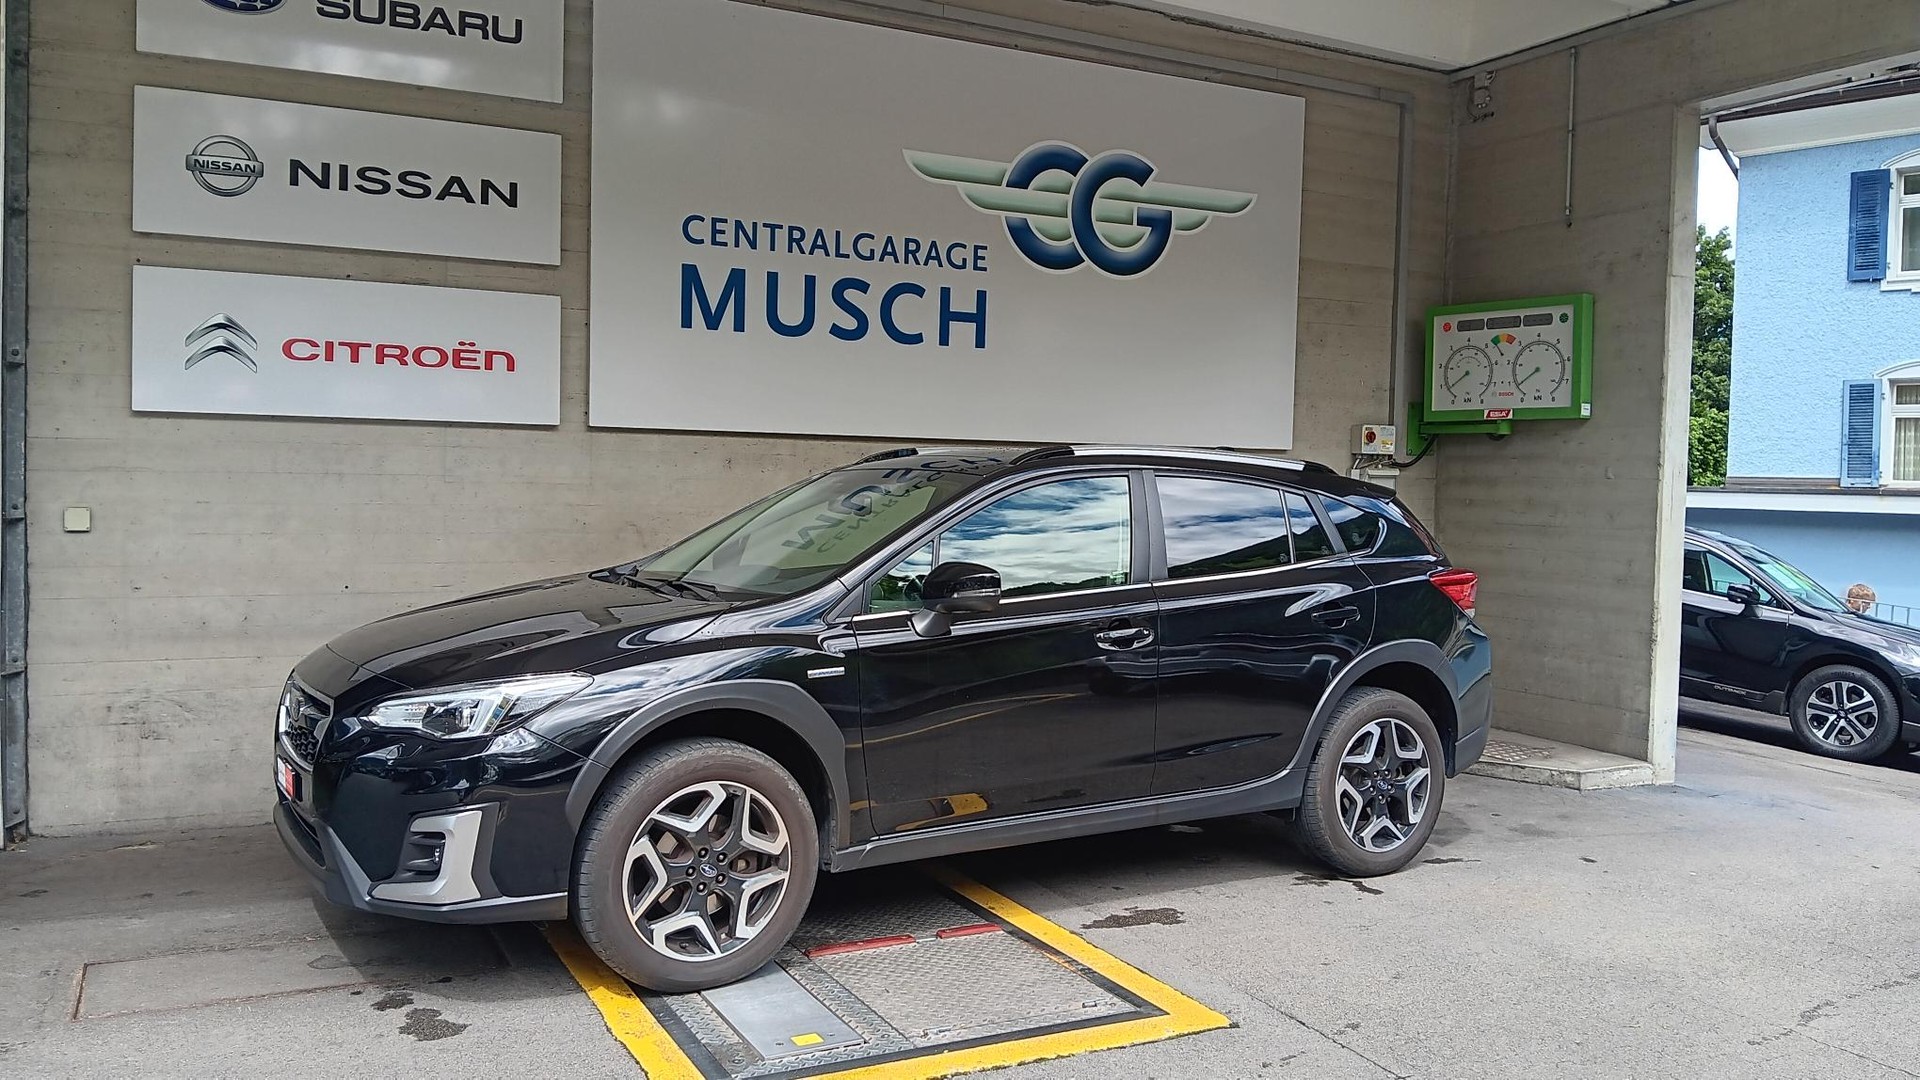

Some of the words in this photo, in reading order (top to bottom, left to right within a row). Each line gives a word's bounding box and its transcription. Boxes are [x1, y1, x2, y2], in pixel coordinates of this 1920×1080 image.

[316, 0, 523, 44] SUBARU
[193, 158, 256, 173] NISSAN
[289, 158, 518, 208] NISSAN
[681, 215, 988, 271] CENTRALGARAGE
[680, 263, 988, 349] MUSCH
